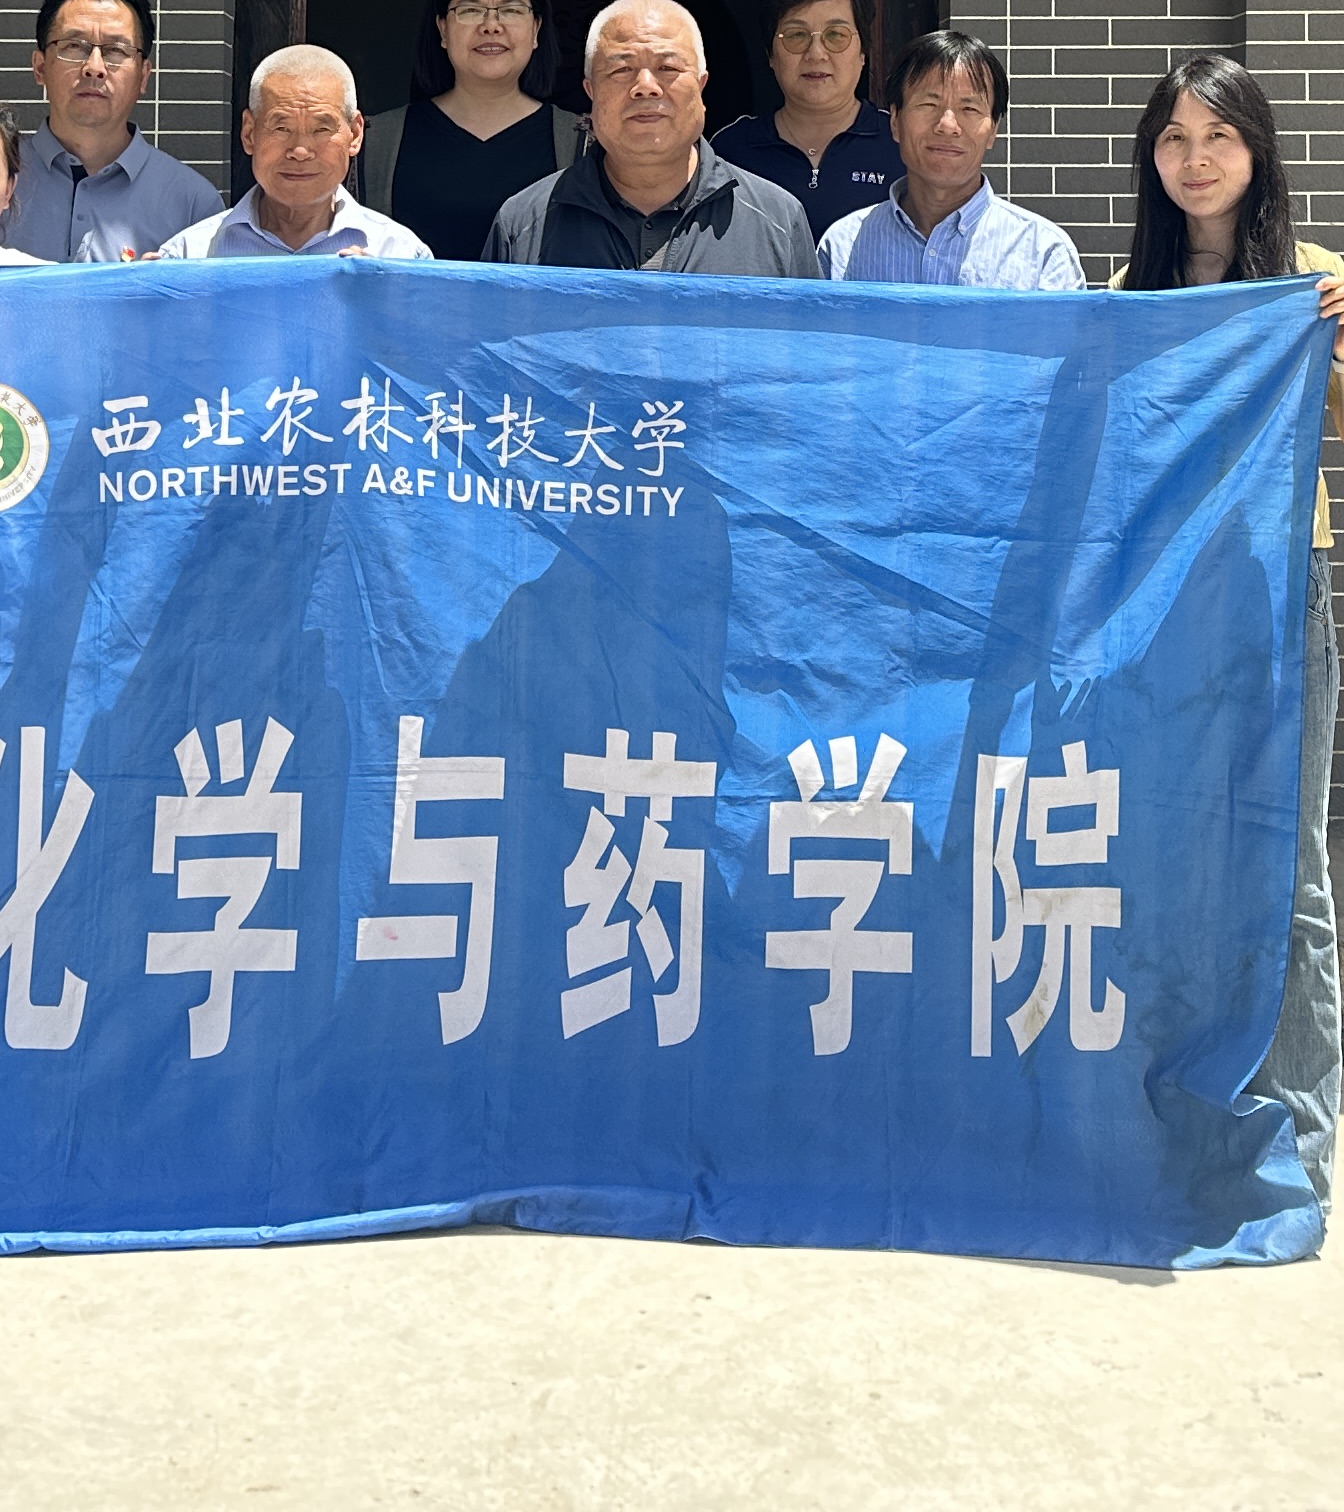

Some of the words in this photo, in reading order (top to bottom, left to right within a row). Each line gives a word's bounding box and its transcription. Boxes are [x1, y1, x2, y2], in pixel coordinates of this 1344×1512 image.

[851, 171, 886, 185] STAY
[91, 376, 687, 477] 西北农林科技大学
[99, 463, 352, 503] NORTHWEST
[361, 463, 436, 496] A&F
[447, 473, 685, 517] UNIVERSITY
